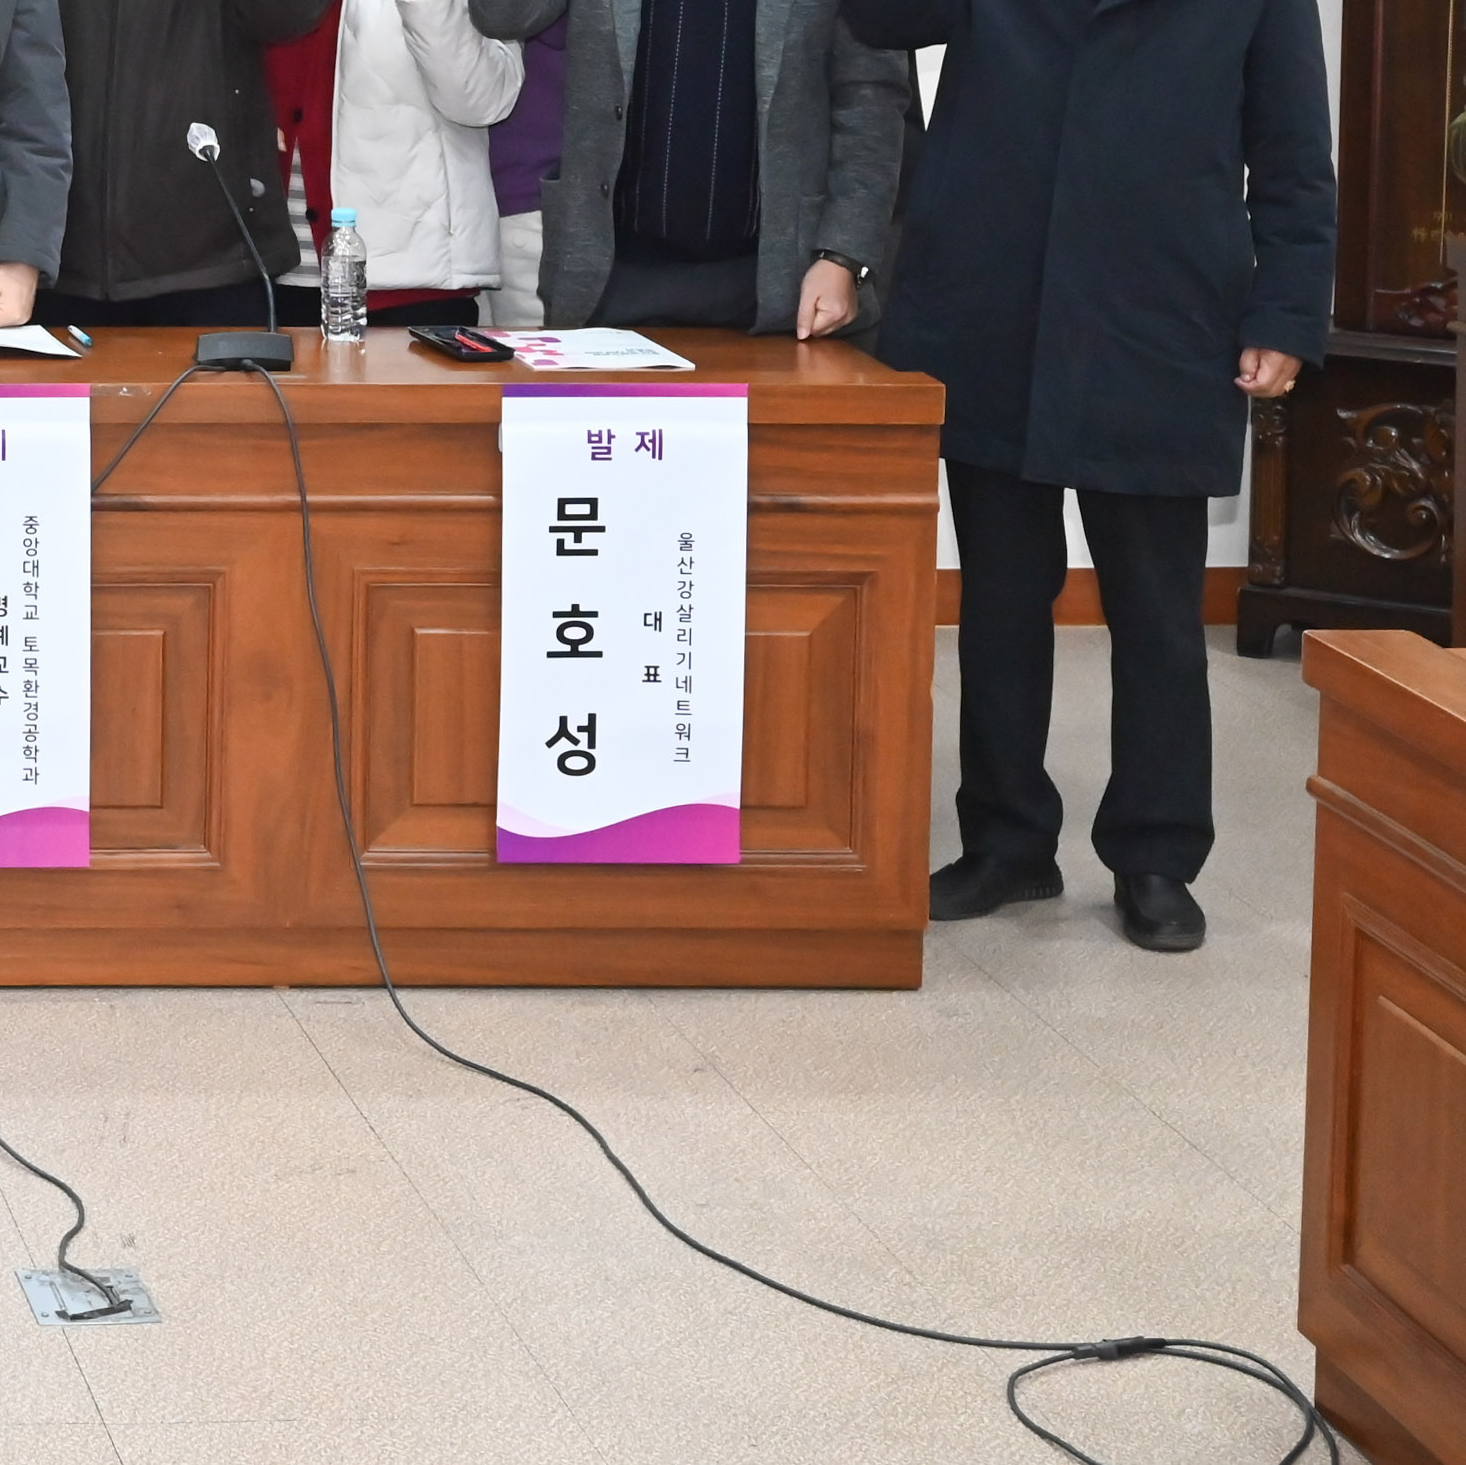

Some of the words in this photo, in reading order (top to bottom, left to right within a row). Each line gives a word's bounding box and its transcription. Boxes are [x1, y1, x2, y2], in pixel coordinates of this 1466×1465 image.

[22, 515, 40, 620] 중앙대학교
[22, 636, 40, 785] 토목환경공학과
[673, 532, 695, 763] 울산강살리기네트워크
